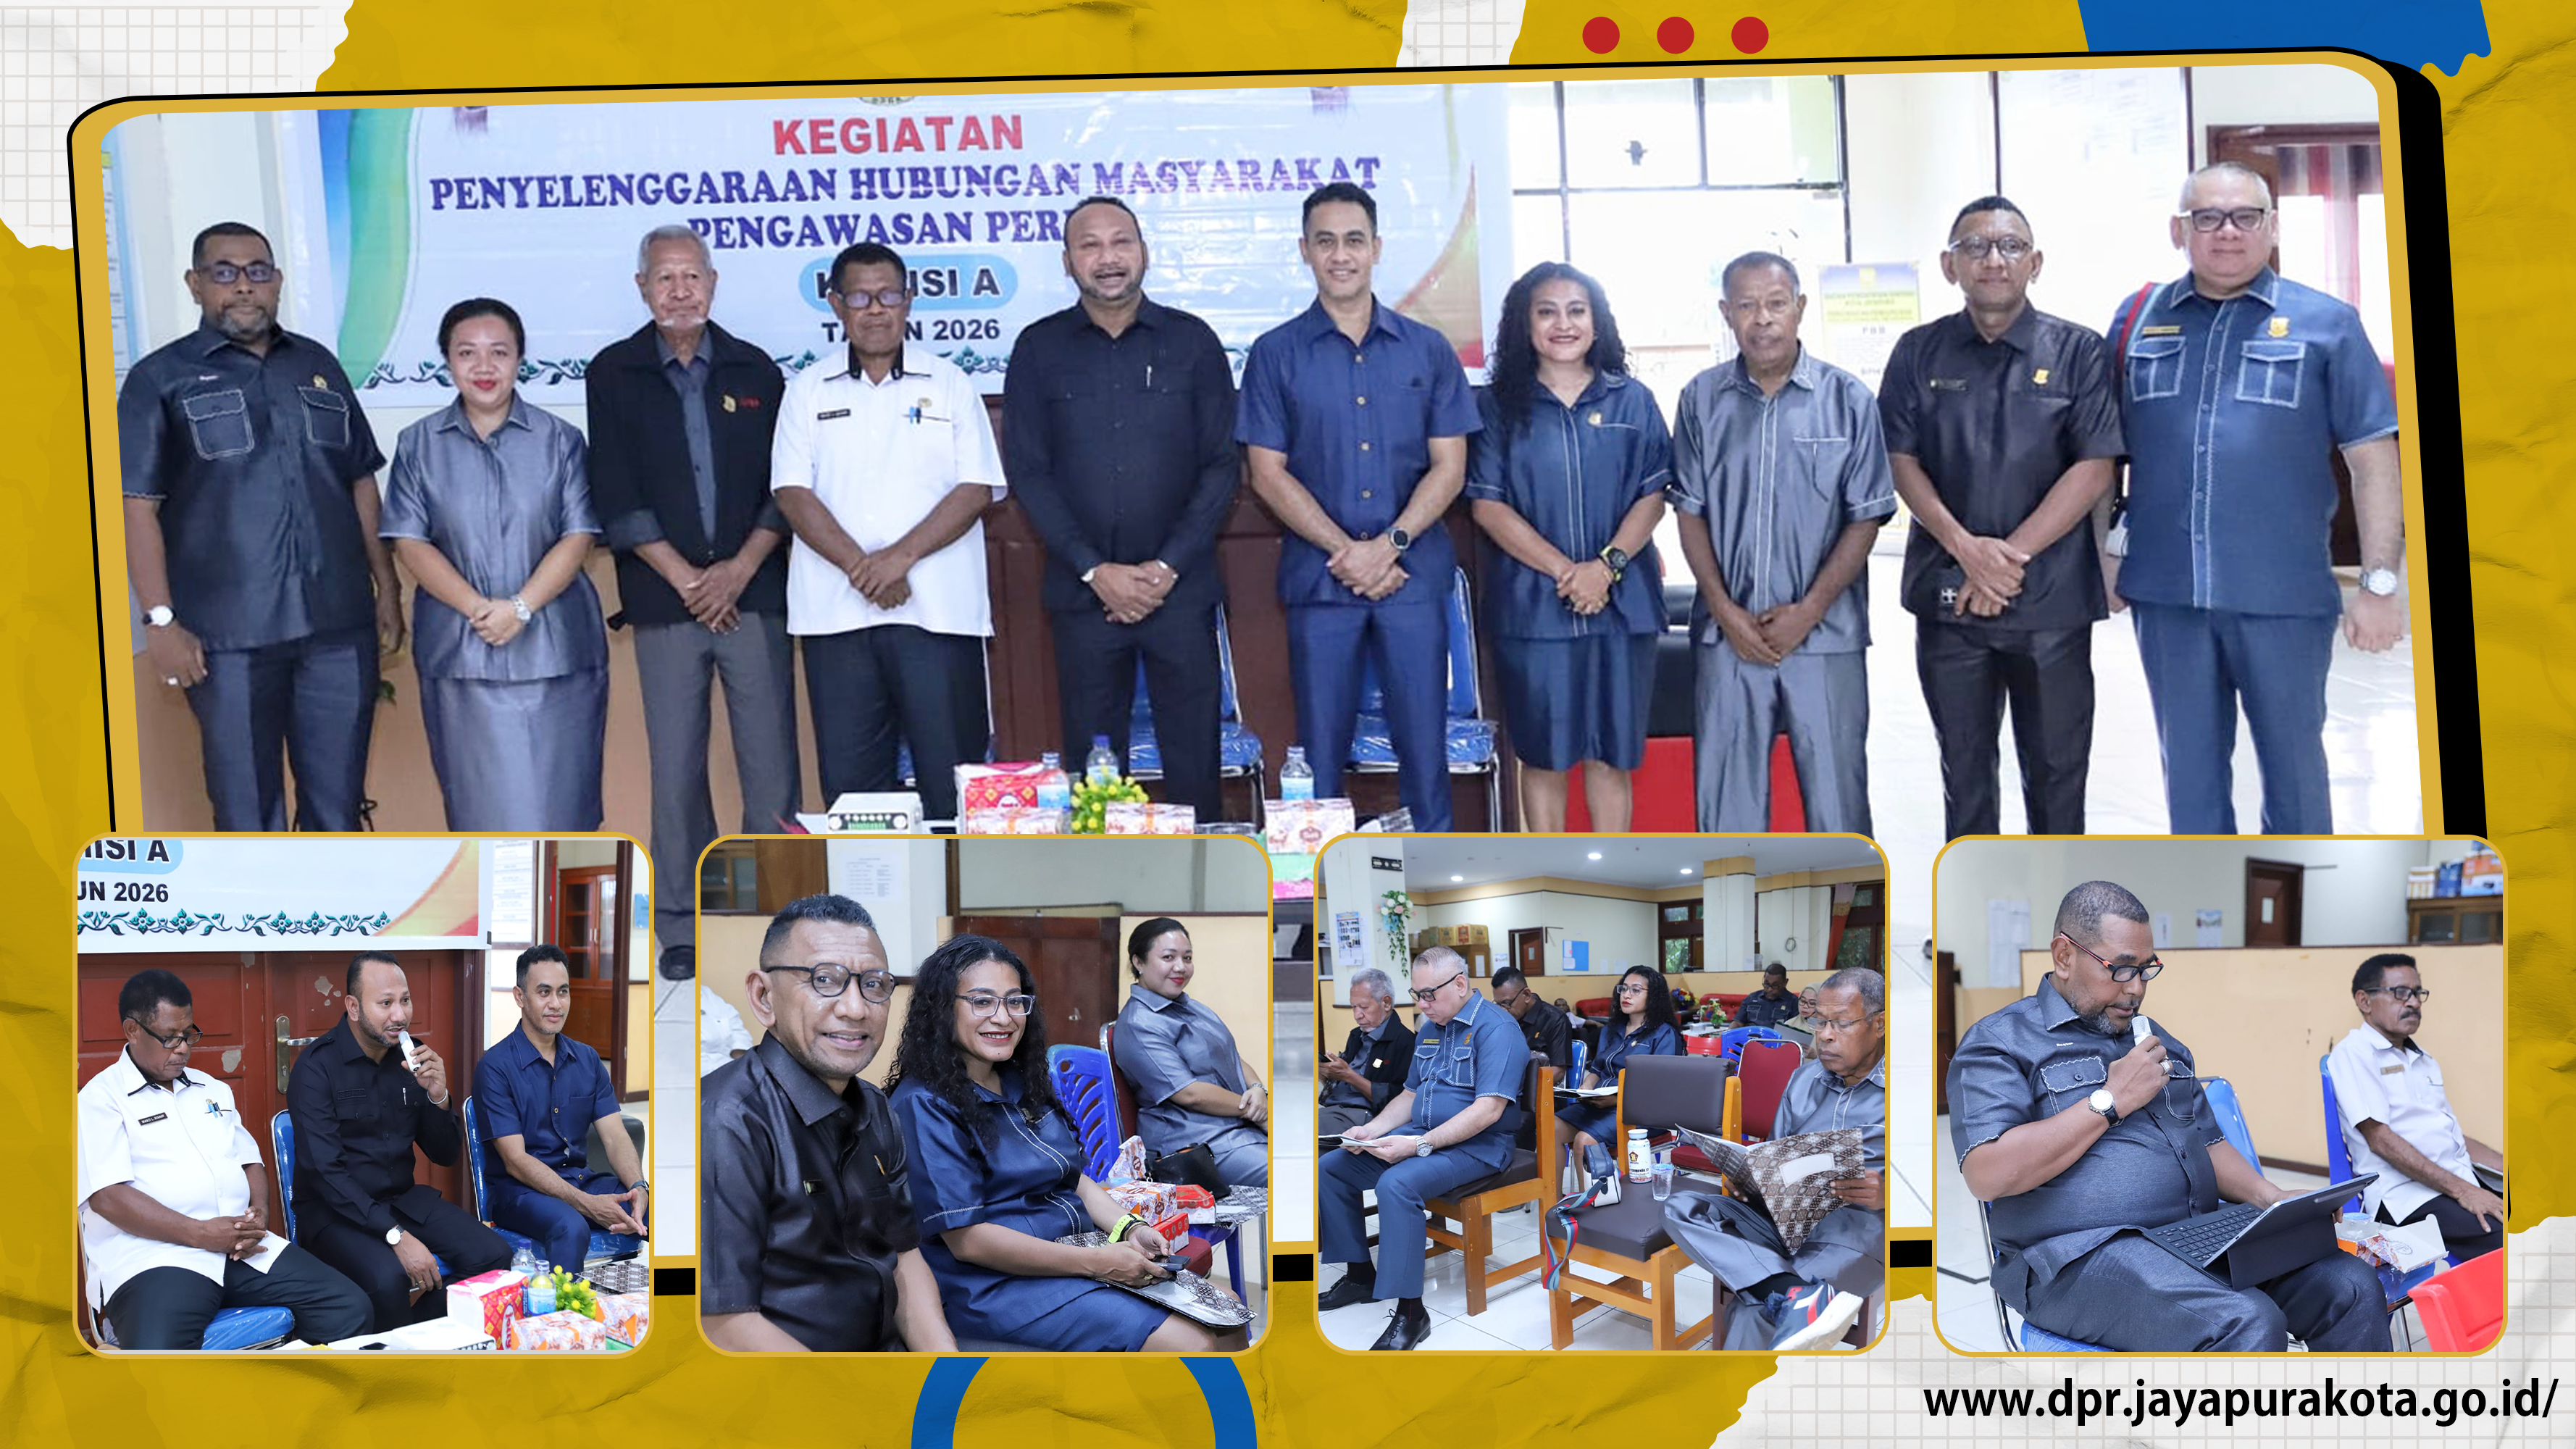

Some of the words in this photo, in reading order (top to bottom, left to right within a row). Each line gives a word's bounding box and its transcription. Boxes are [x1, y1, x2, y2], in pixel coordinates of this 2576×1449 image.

[773, 114, 1024, 155] KEGIATAN
[429, 169, 837, 211] PENYELENGGARAAN
[848, 162, 1082, 200] HUBUNGAN
[1092, 156, 1381, 194] MASYARAKAT
[687, 211, 973, 249] PENGAWASAN
[984, 209, 1072, 242] PER
[973, 268, 1000, 296] A
[932, 318, 1000, 341] 2026
[147, 840, 170, 862] A
[114, 882, 169, 903] 2026
